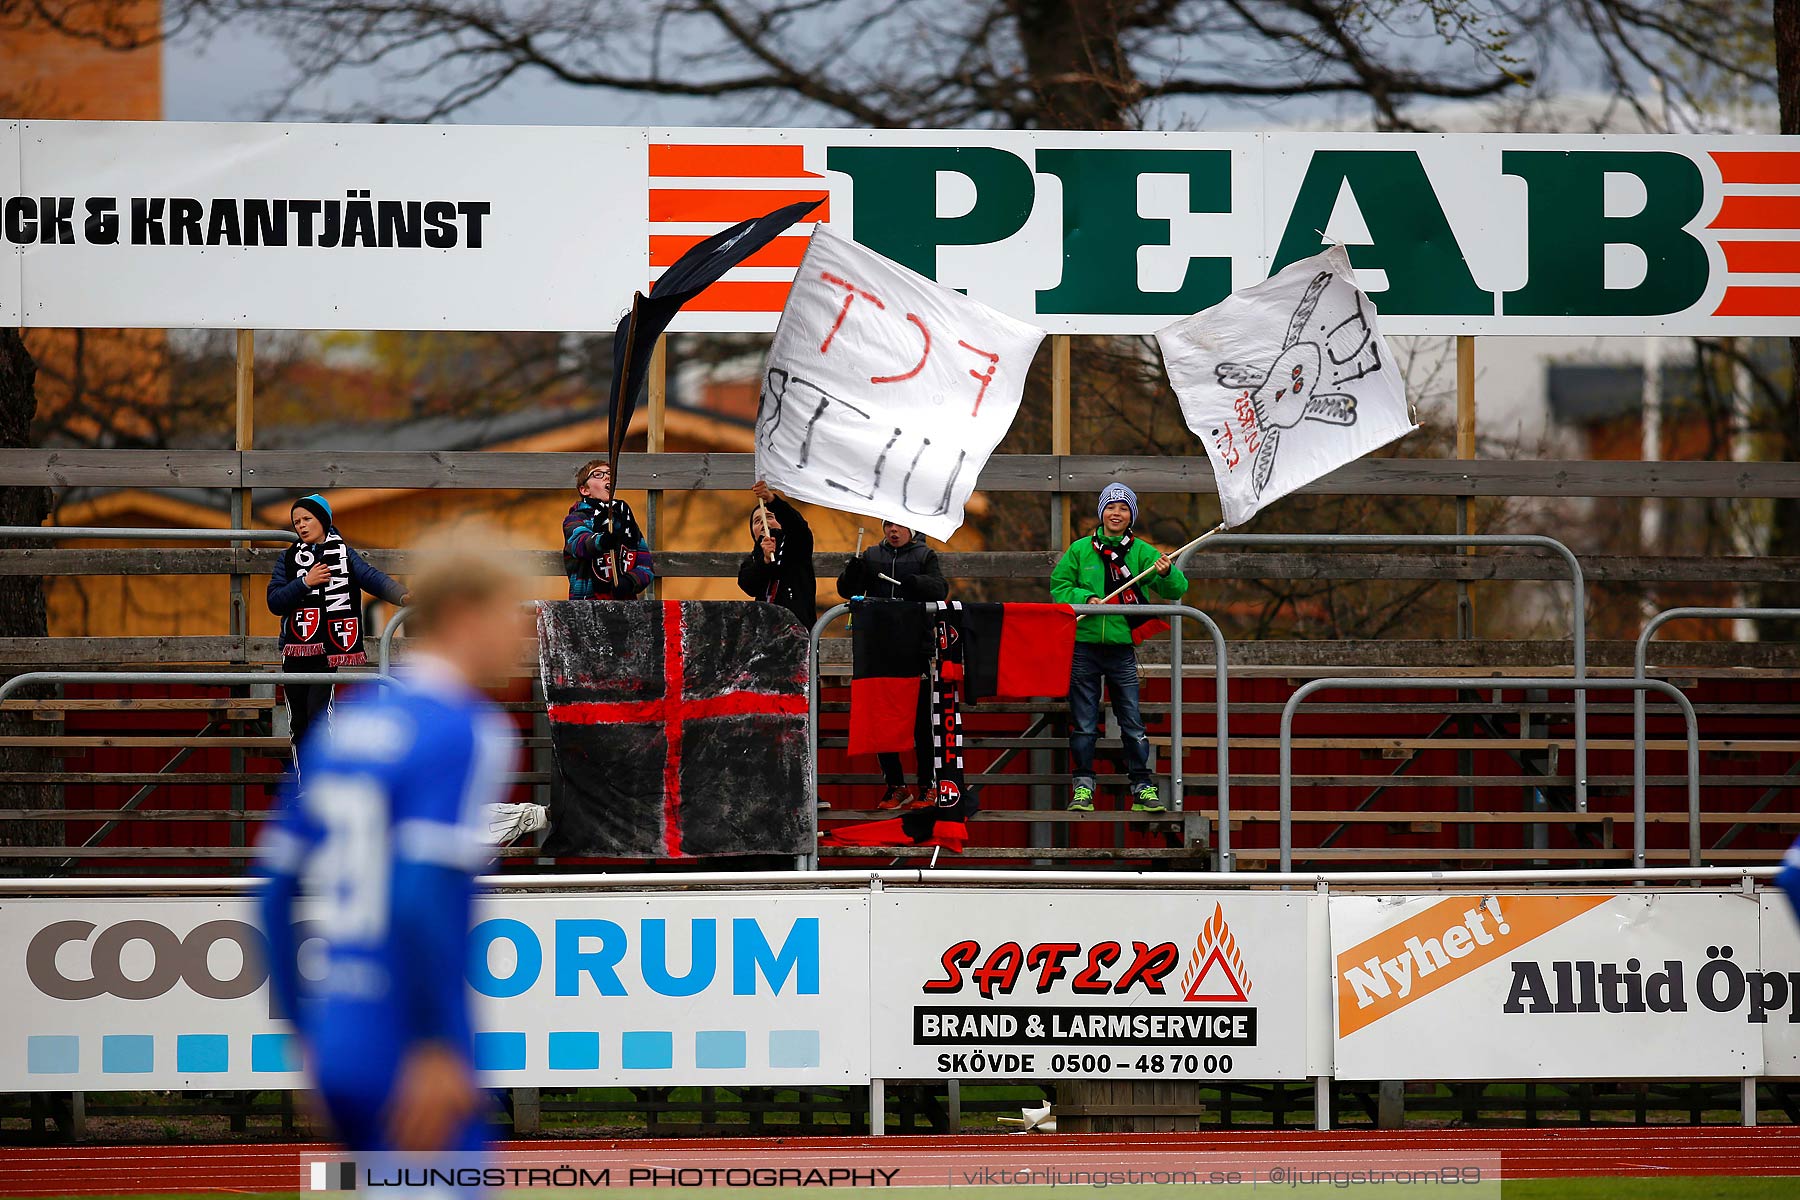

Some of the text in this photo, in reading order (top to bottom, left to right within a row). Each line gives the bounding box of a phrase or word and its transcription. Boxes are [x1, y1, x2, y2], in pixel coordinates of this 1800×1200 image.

[0, 190, 491, 249] CK & KRANTJÄNST
[826, 146, 1710, 317] PEAB
[922, 939, 1179, 1000] SAFER
[1344, 895, 1511, 1010] Nyhet!
[1503, 957, 1687, 1013] Alltid
[922, 1014, 1249, 1039] BRAND & LARMSERVICE
[937, 1050, 1035, 1073] SKÖVDE
[1051, 1054, 1111, 1073] 0500
